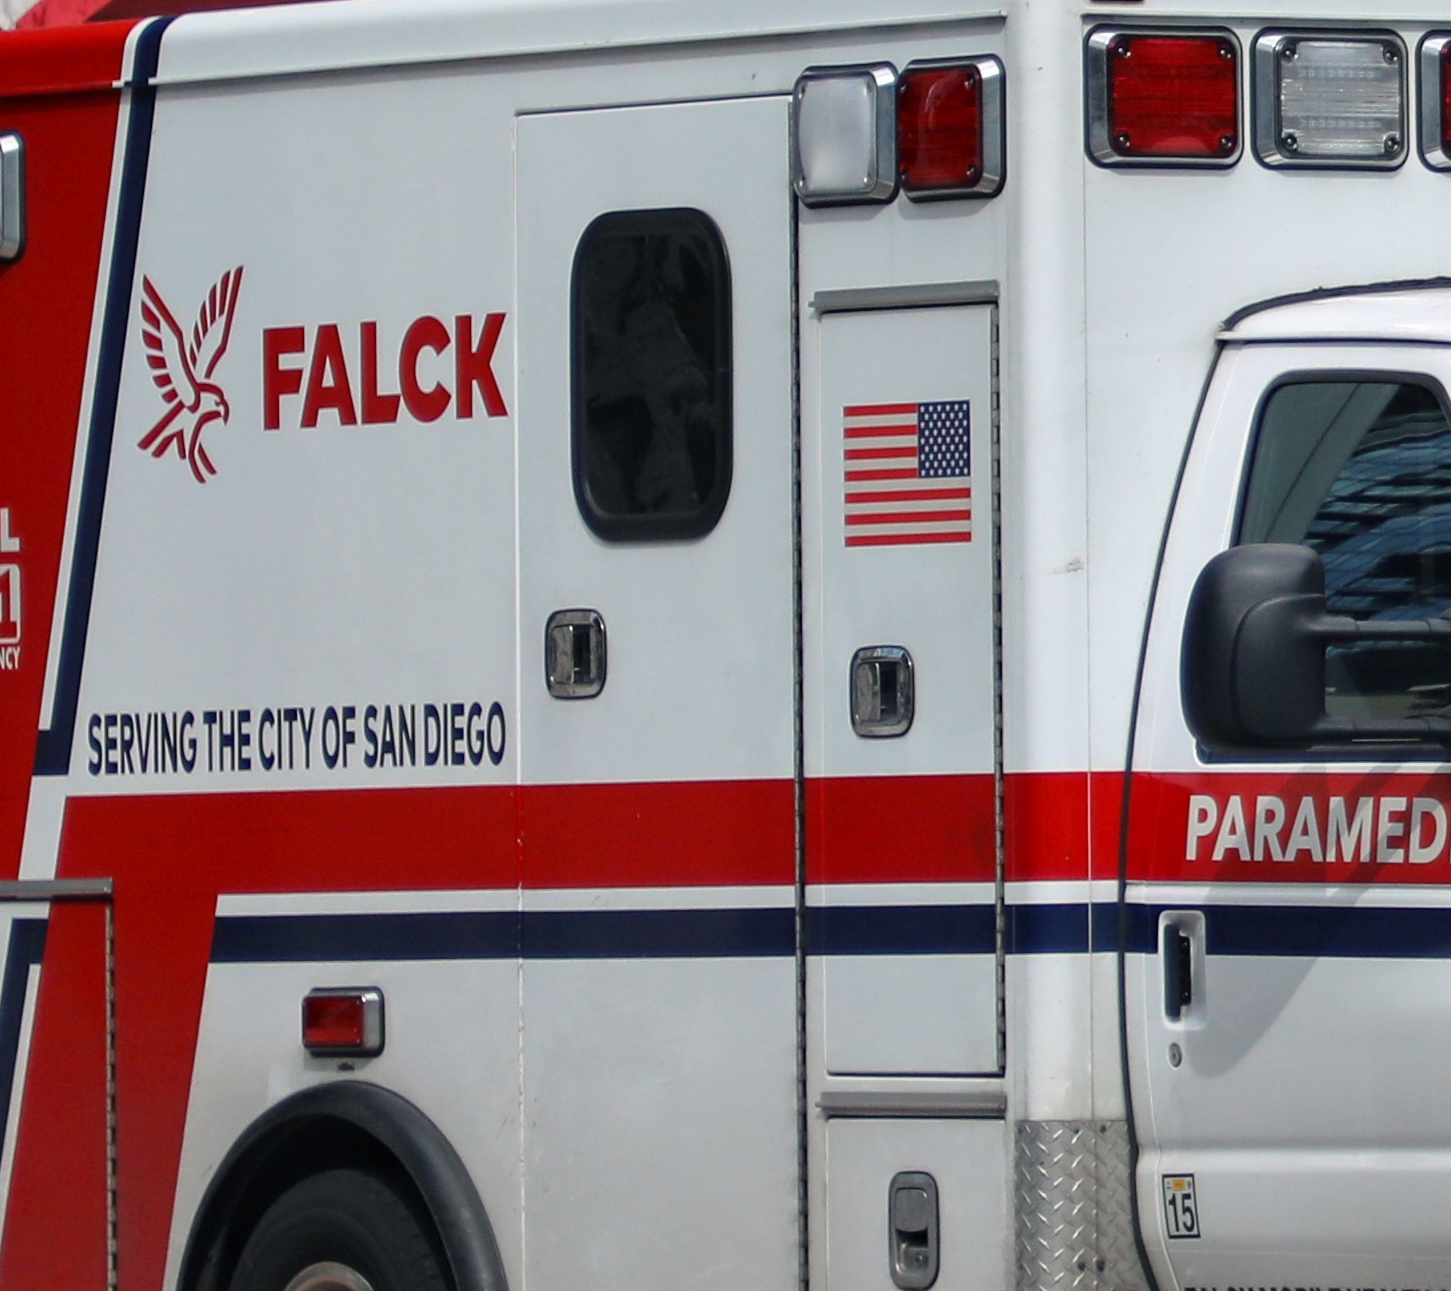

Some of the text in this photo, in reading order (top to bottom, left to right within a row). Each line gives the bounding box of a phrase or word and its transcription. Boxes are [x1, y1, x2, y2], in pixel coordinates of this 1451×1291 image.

[261, 312, 508, 431] FALCK
[88, 701, 507, 776] SERVING THE CITY OF SAN DIEGO
[1168, 1193, 1195, 1232] 15
